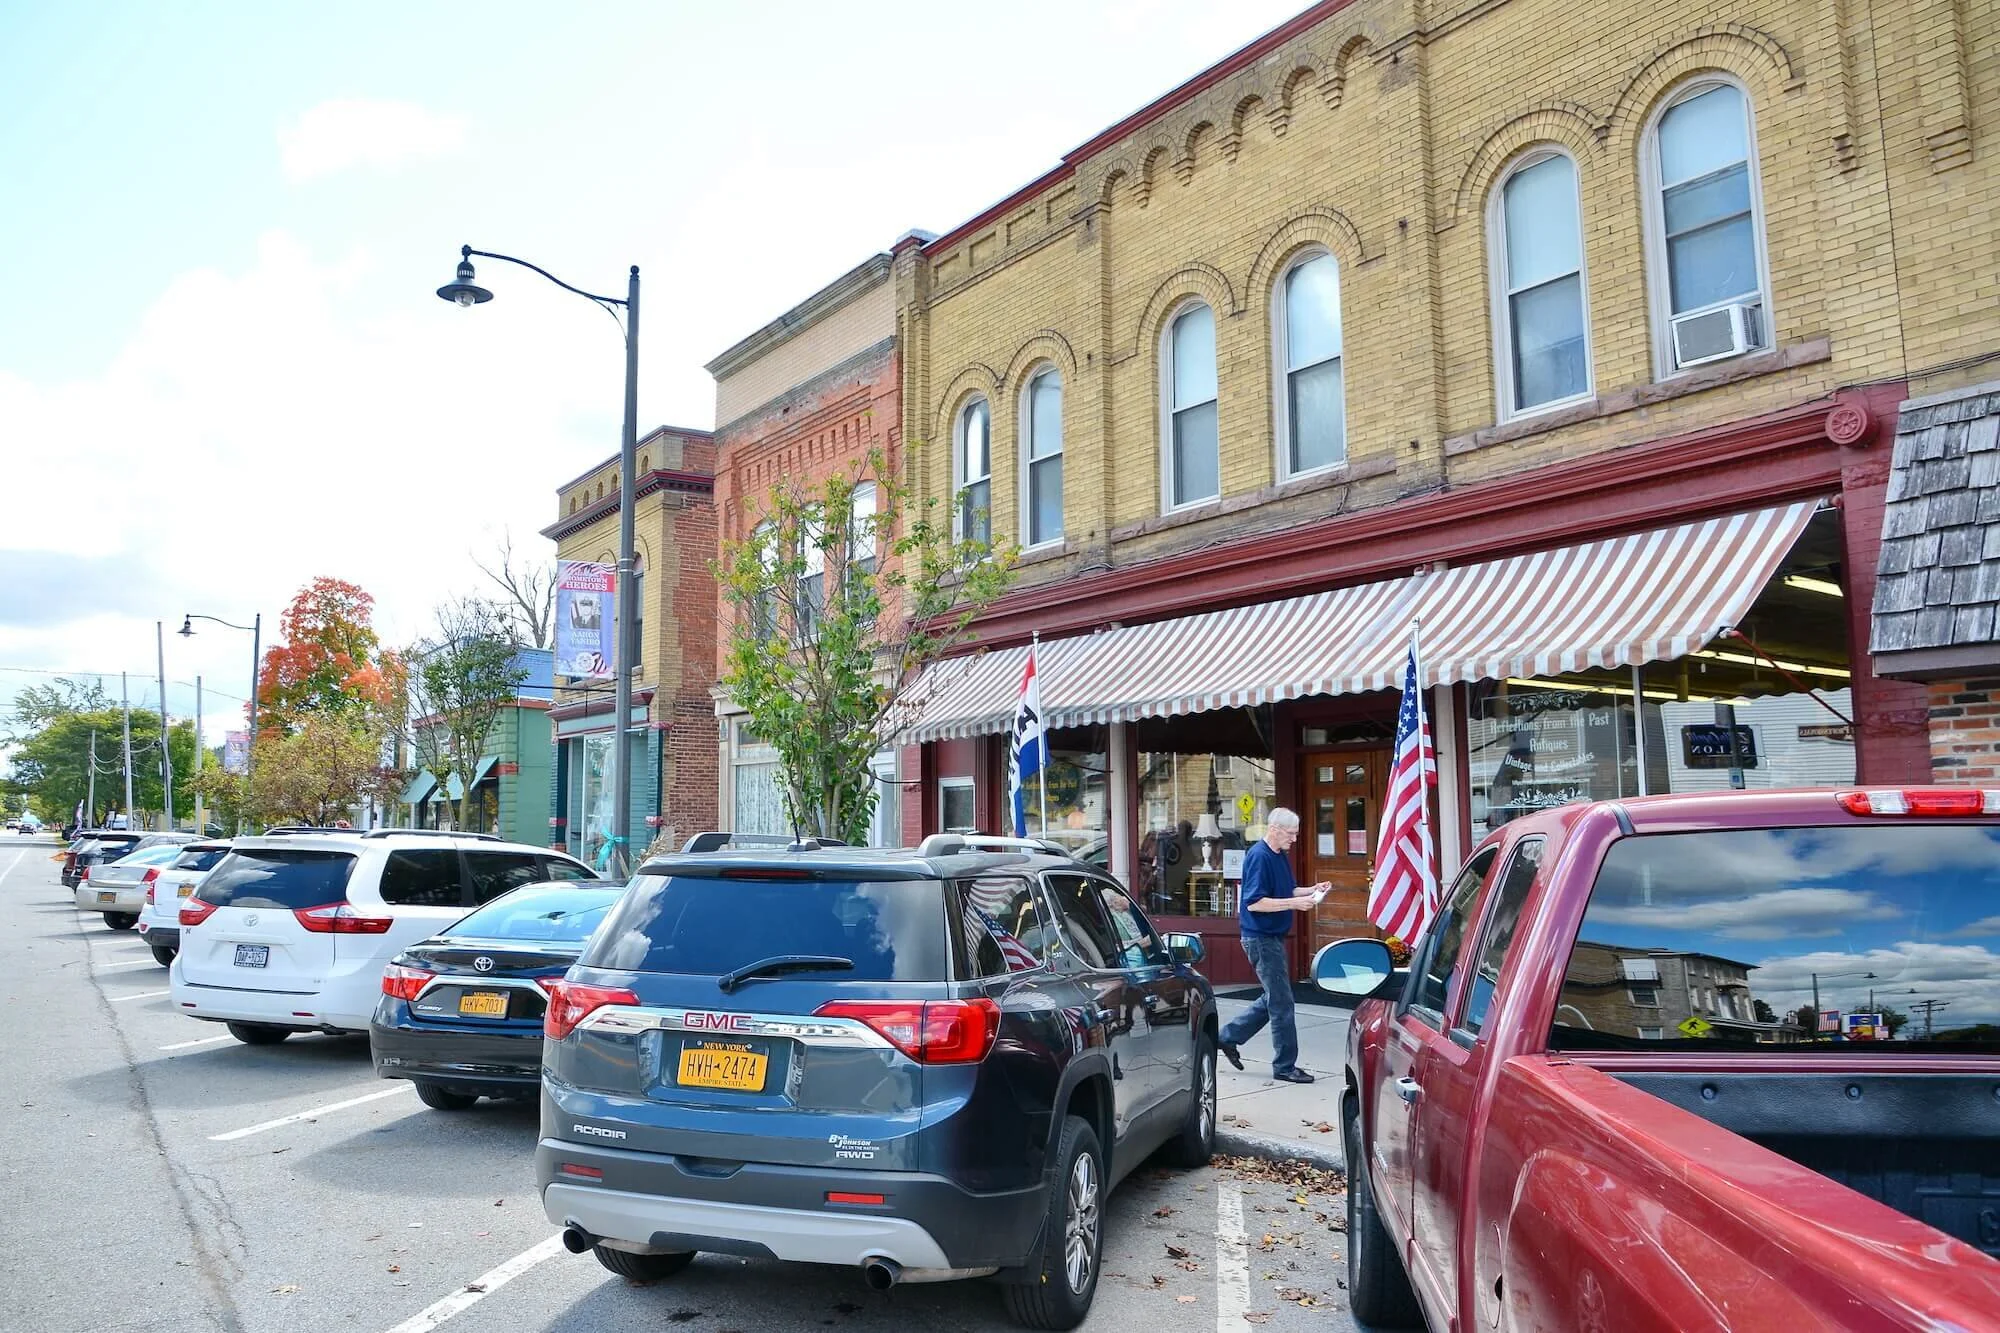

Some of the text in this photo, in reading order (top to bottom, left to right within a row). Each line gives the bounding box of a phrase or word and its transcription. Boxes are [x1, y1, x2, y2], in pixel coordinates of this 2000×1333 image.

[566, 581, 608, 591] HEROES
[1490, 711, 1610, 734] Reflections from the Past
[1529, 738, 1569, 752] Antiques
[1505, 754, 1533, 772] Vintage
[684, 1012, 752, 1031] GMC
[703, 1042, 748, 1052] NEW YORK
[699, 1078, 741, 1087] EMPIRE STATE
[573, 1124, 627, 1139] ACADIA
[835, 1151, 874, 1159] AWD
